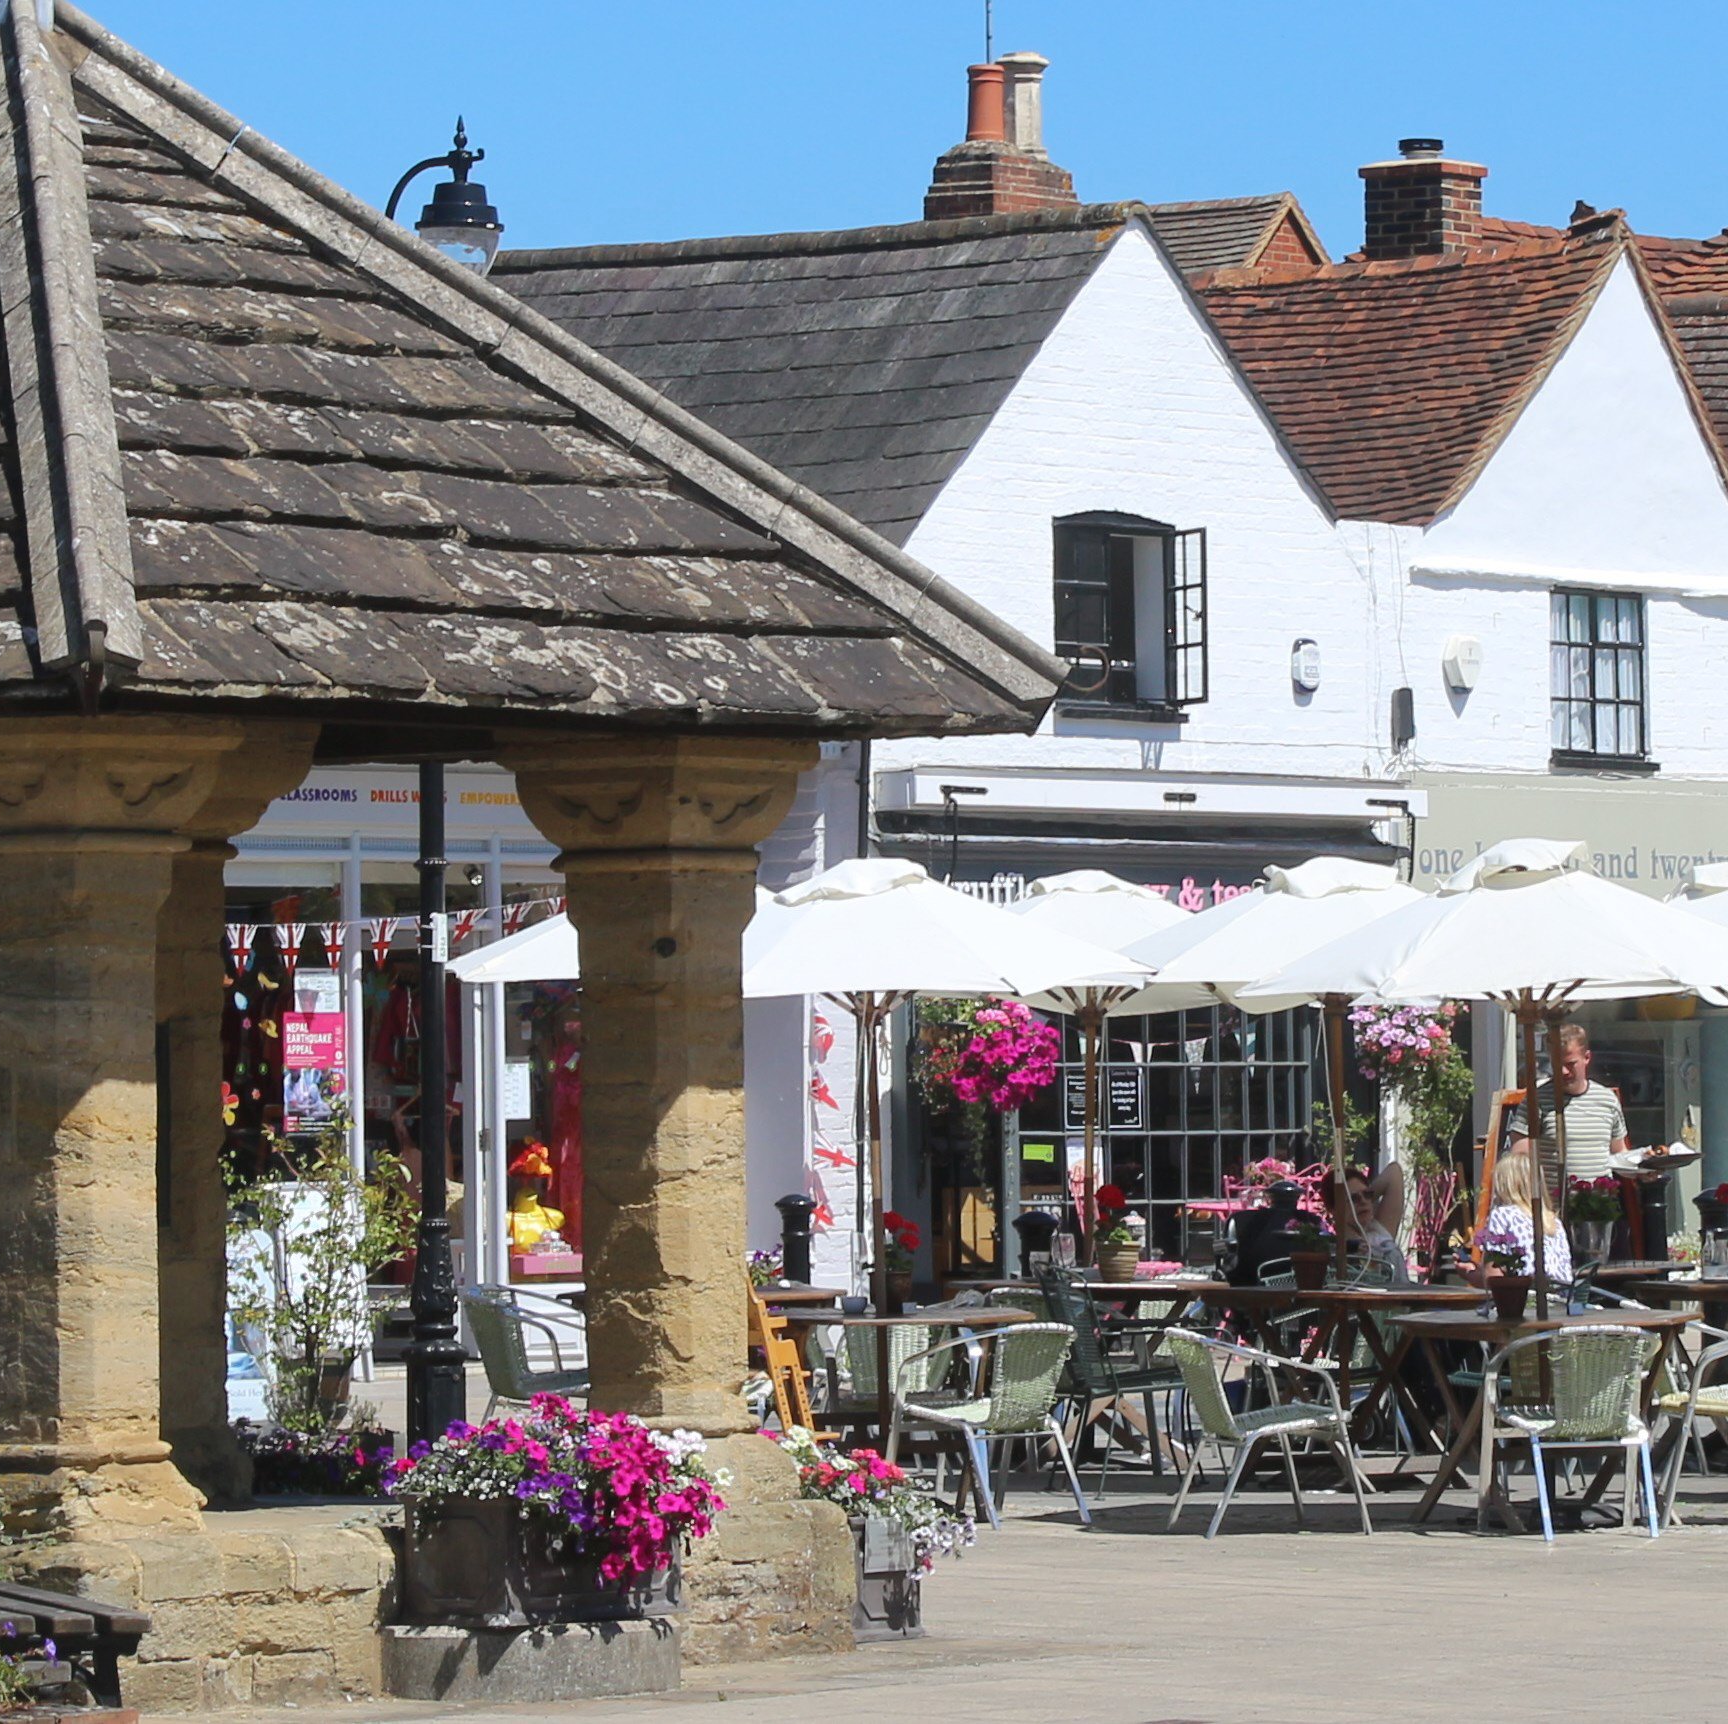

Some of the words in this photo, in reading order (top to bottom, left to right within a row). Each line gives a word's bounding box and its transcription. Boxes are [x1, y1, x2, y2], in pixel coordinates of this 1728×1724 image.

[371, 789, 408, 803] DRILLS
[459, 791, 521, 805] EMPOWER
[1418, 848, 1464, 877] one
[1590, 846, 1639, 880] and
[1178, 876, 1205, 911] &
[286, 1023, 309, 1033] NEPAL
[286, 1033, 333, 1044] EARTHQUAKE
[286, 1044, 314, 1055] APPEAL
